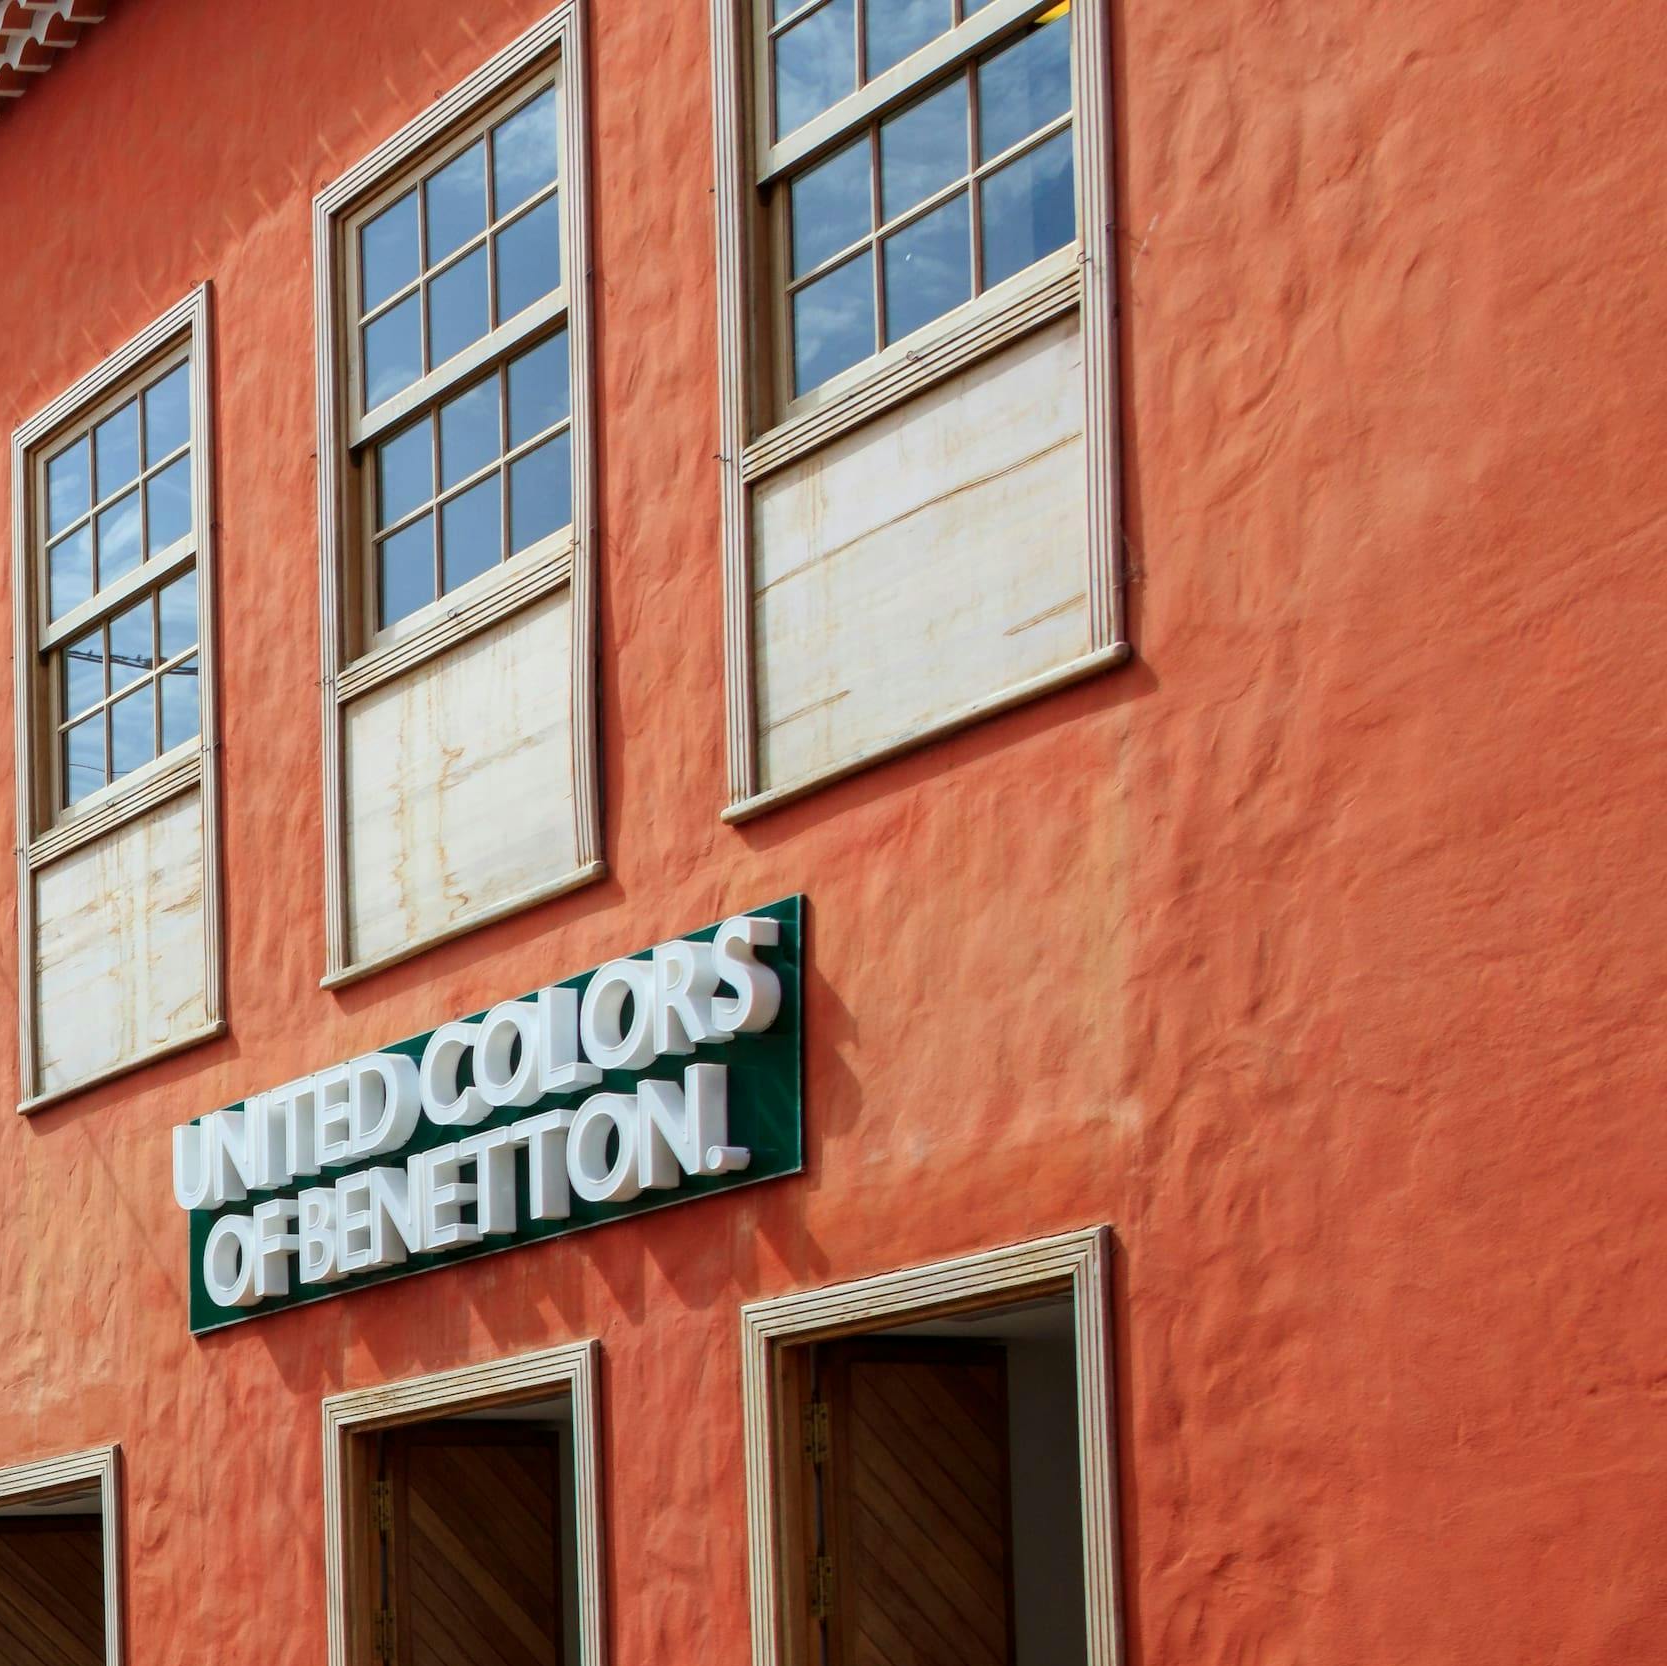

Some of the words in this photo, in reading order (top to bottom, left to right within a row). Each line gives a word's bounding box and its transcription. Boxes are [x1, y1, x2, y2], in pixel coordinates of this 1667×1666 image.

[173, 1053, 422, 1210] UNITED
[419, 916, 781, 1126] COLORS
[203, 1197, 300, 1308] OF
[298, 1063, 751, 1284] BENETTON.
